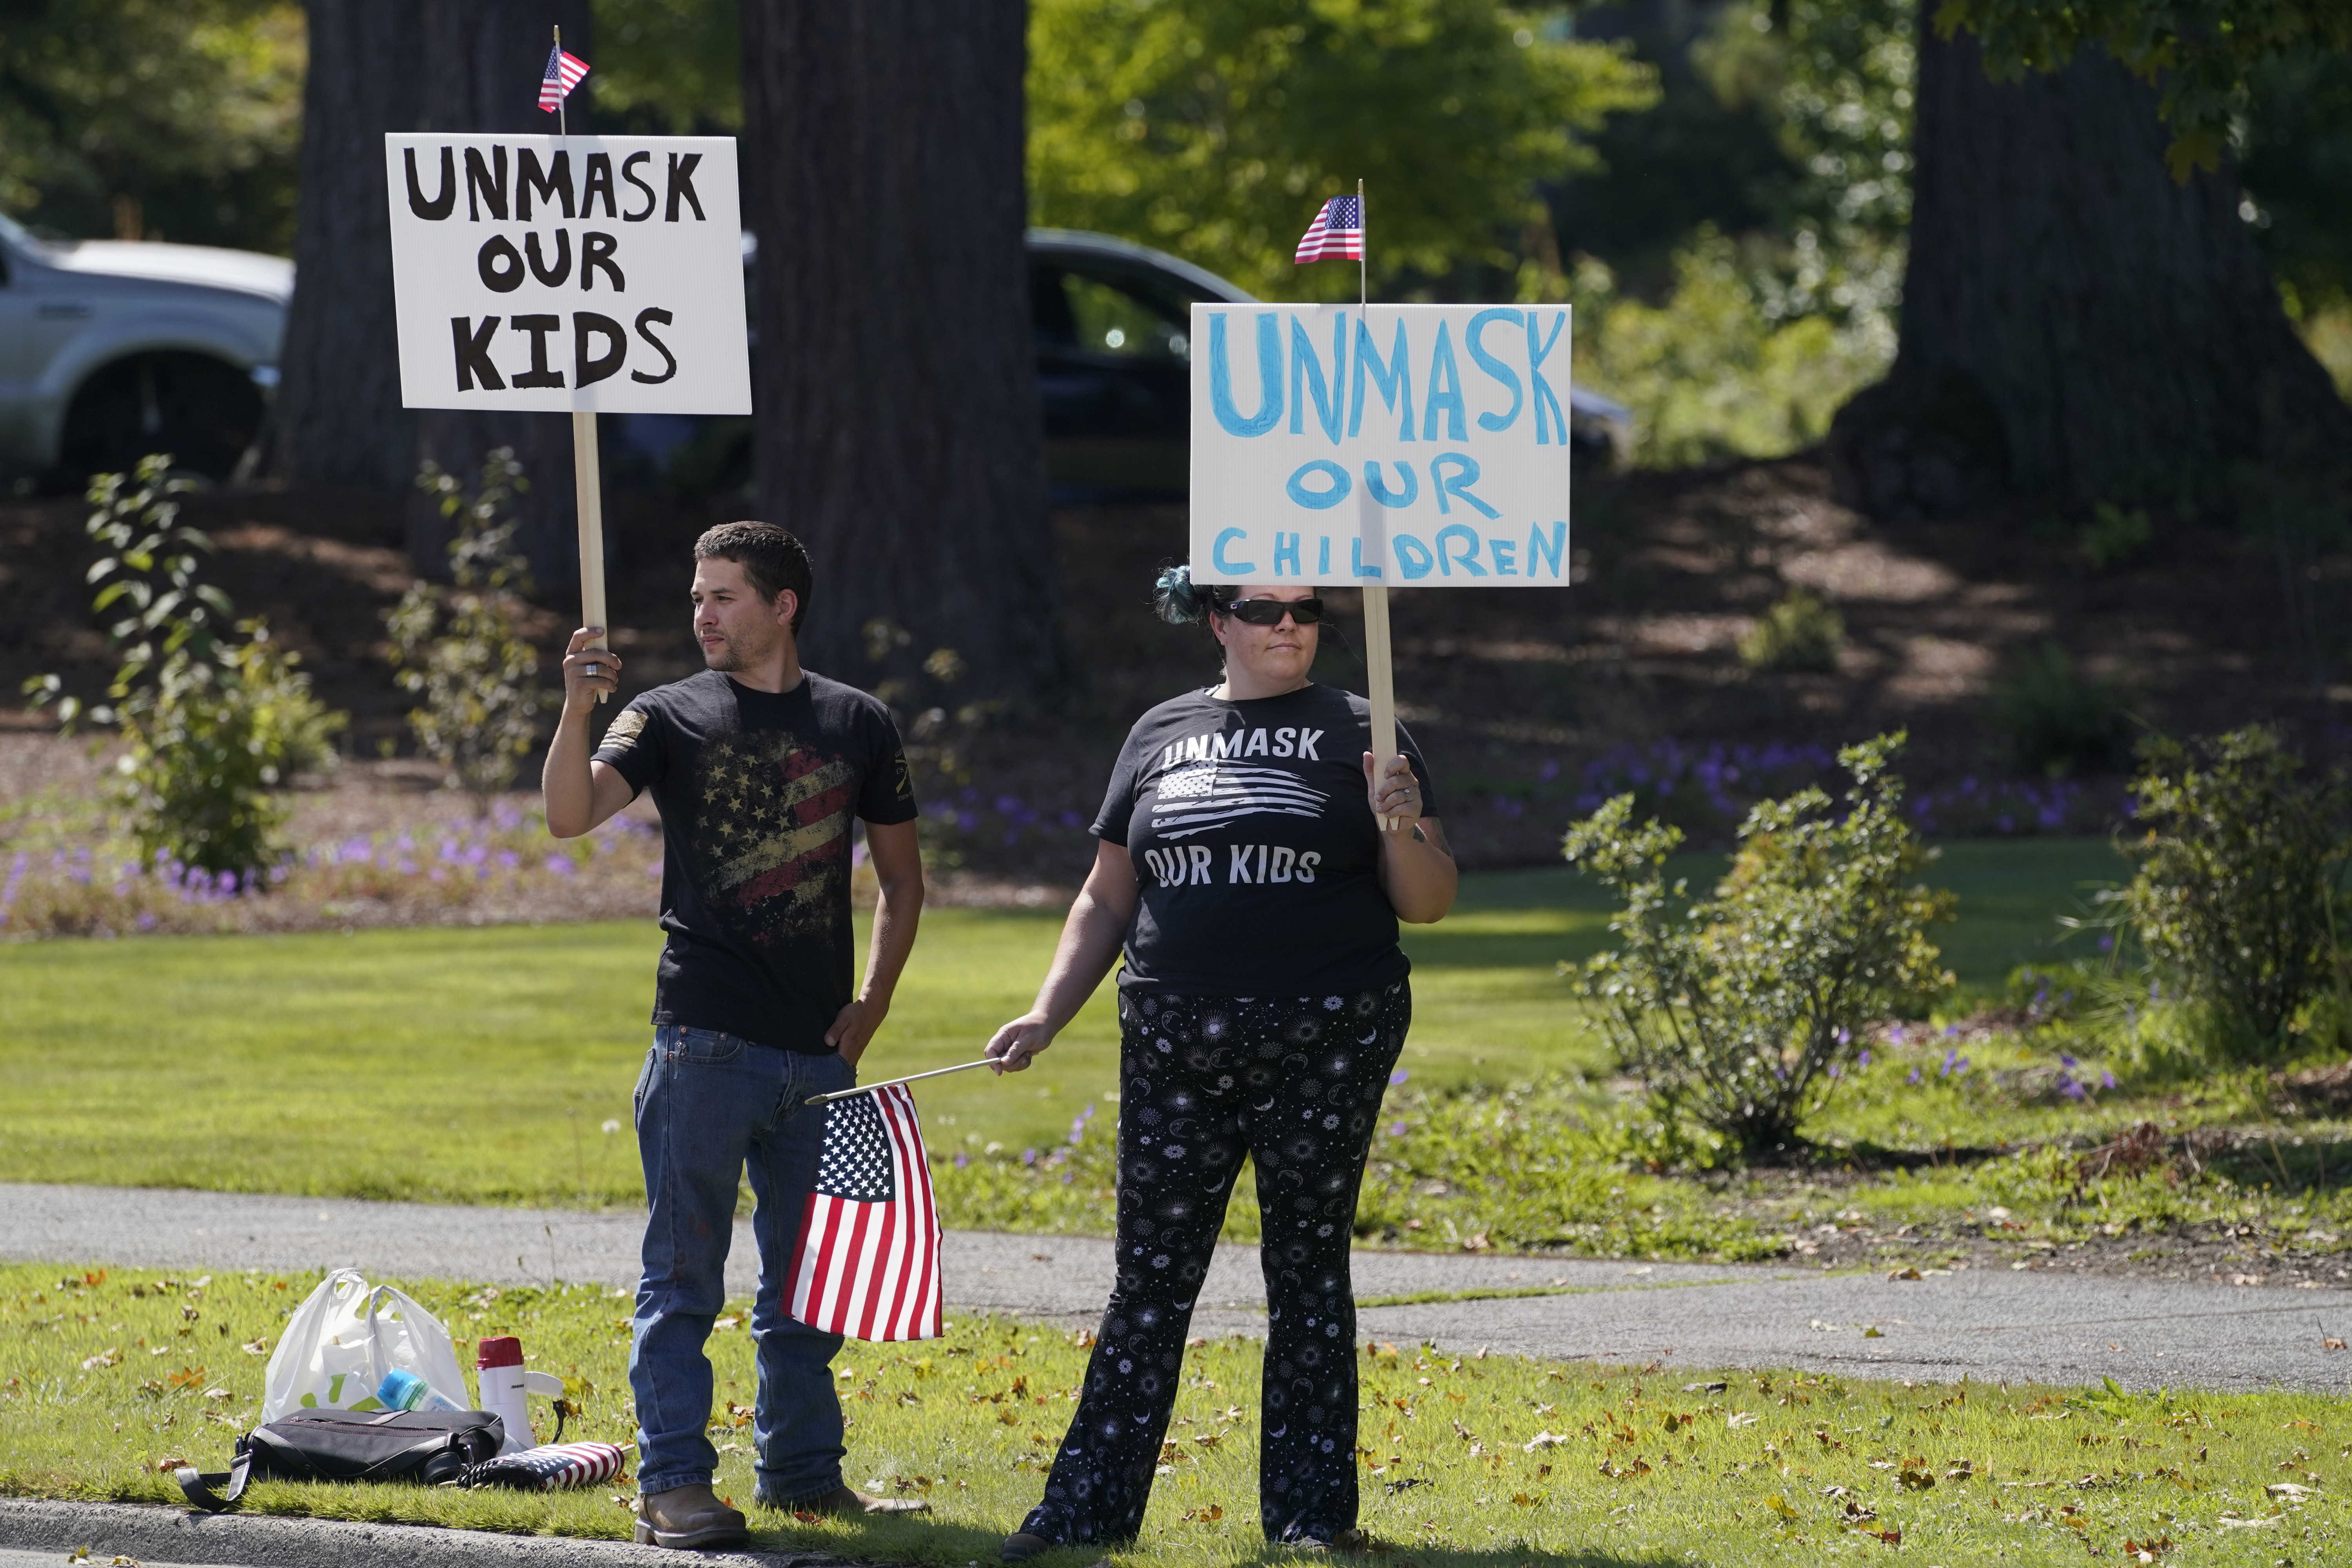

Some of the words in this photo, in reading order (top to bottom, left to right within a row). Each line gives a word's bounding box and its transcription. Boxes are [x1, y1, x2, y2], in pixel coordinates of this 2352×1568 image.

[404, 144, 706, 222] UNMASK
[477, 228, 625, 293] OUR
[451, 307, 677, 392] KIDS
[1207, 308, 1568, 446] UNMASK
[1286, 452, 1504, 520] OUR
[1212, 521, 1567, 580] CHILDREN
[896, 766, 904, 775] US
[1161, 727, 1325, 771] UNMASK
[897, 793, 909, 802] THIS
[1144, 845, 1212, 888] OUR
[1229, 845, 1321, 884] KIDS
